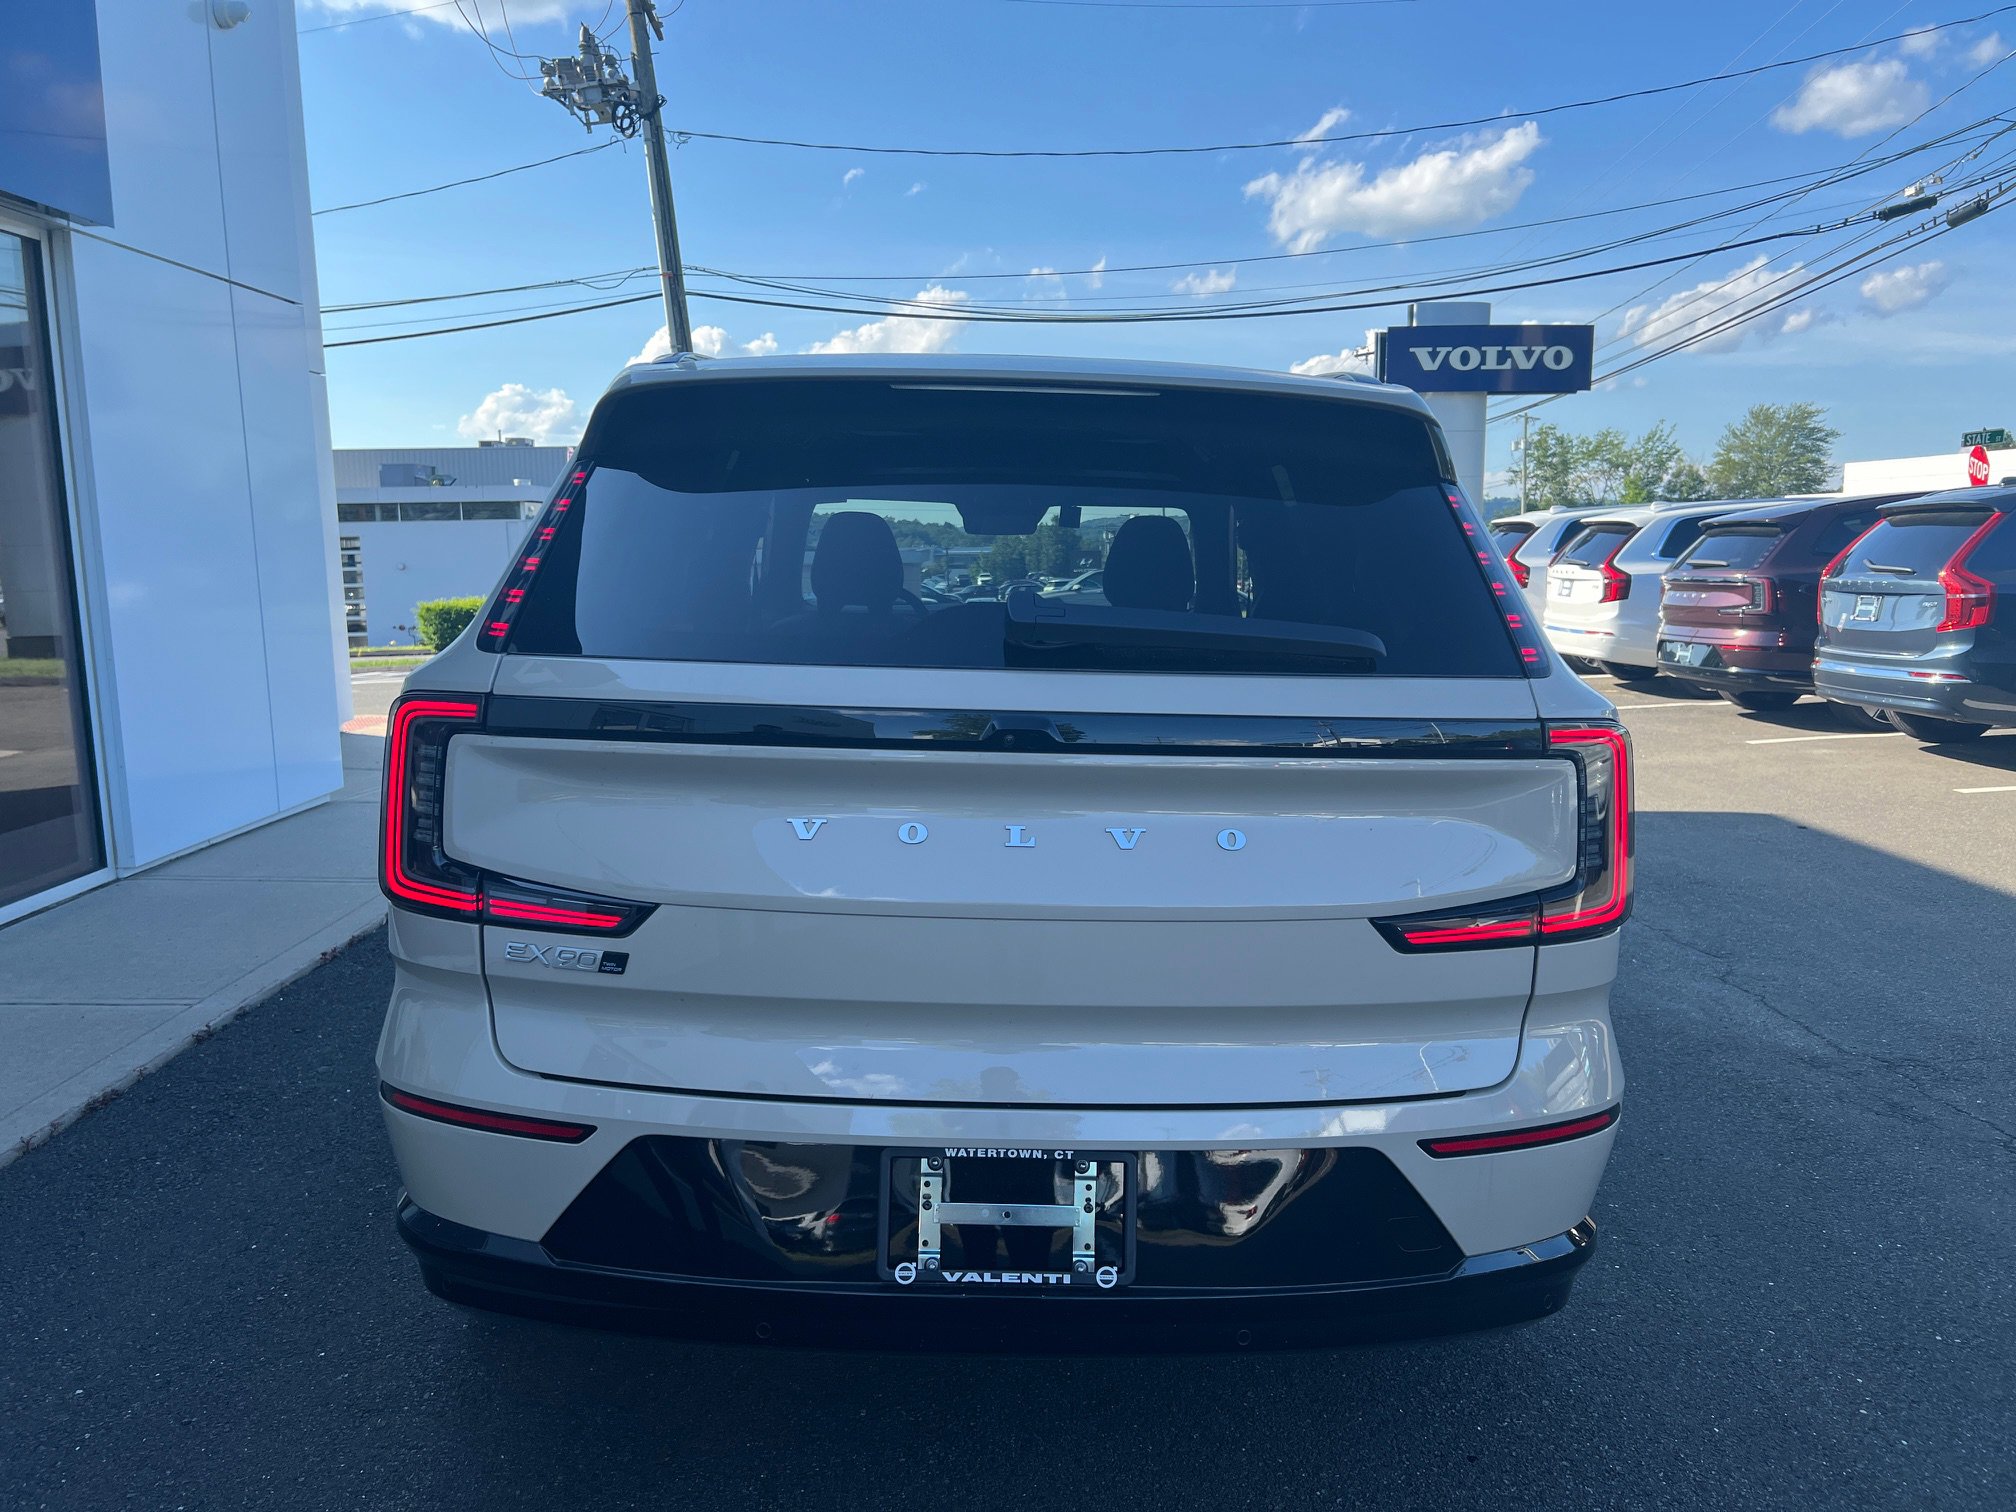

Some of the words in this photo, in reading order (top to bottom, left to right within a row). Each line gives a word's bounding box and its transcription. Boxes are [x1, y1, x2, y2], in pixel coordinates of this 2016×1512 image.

[1409, 345, 1574, 371] VOLVO
[1966, 432, 1991, 445] STATE
[1969, 457, 1989, 481] STOP
[786, 817, 1248, 852] VOLVO
[505, 941, 601, 970] EX90
[944, 1148, 1048, 1160] WATERTOWN,
[1054, 1150, 1074, 1160] CT
[941, 1271, 1071, 1284] VALENTI
